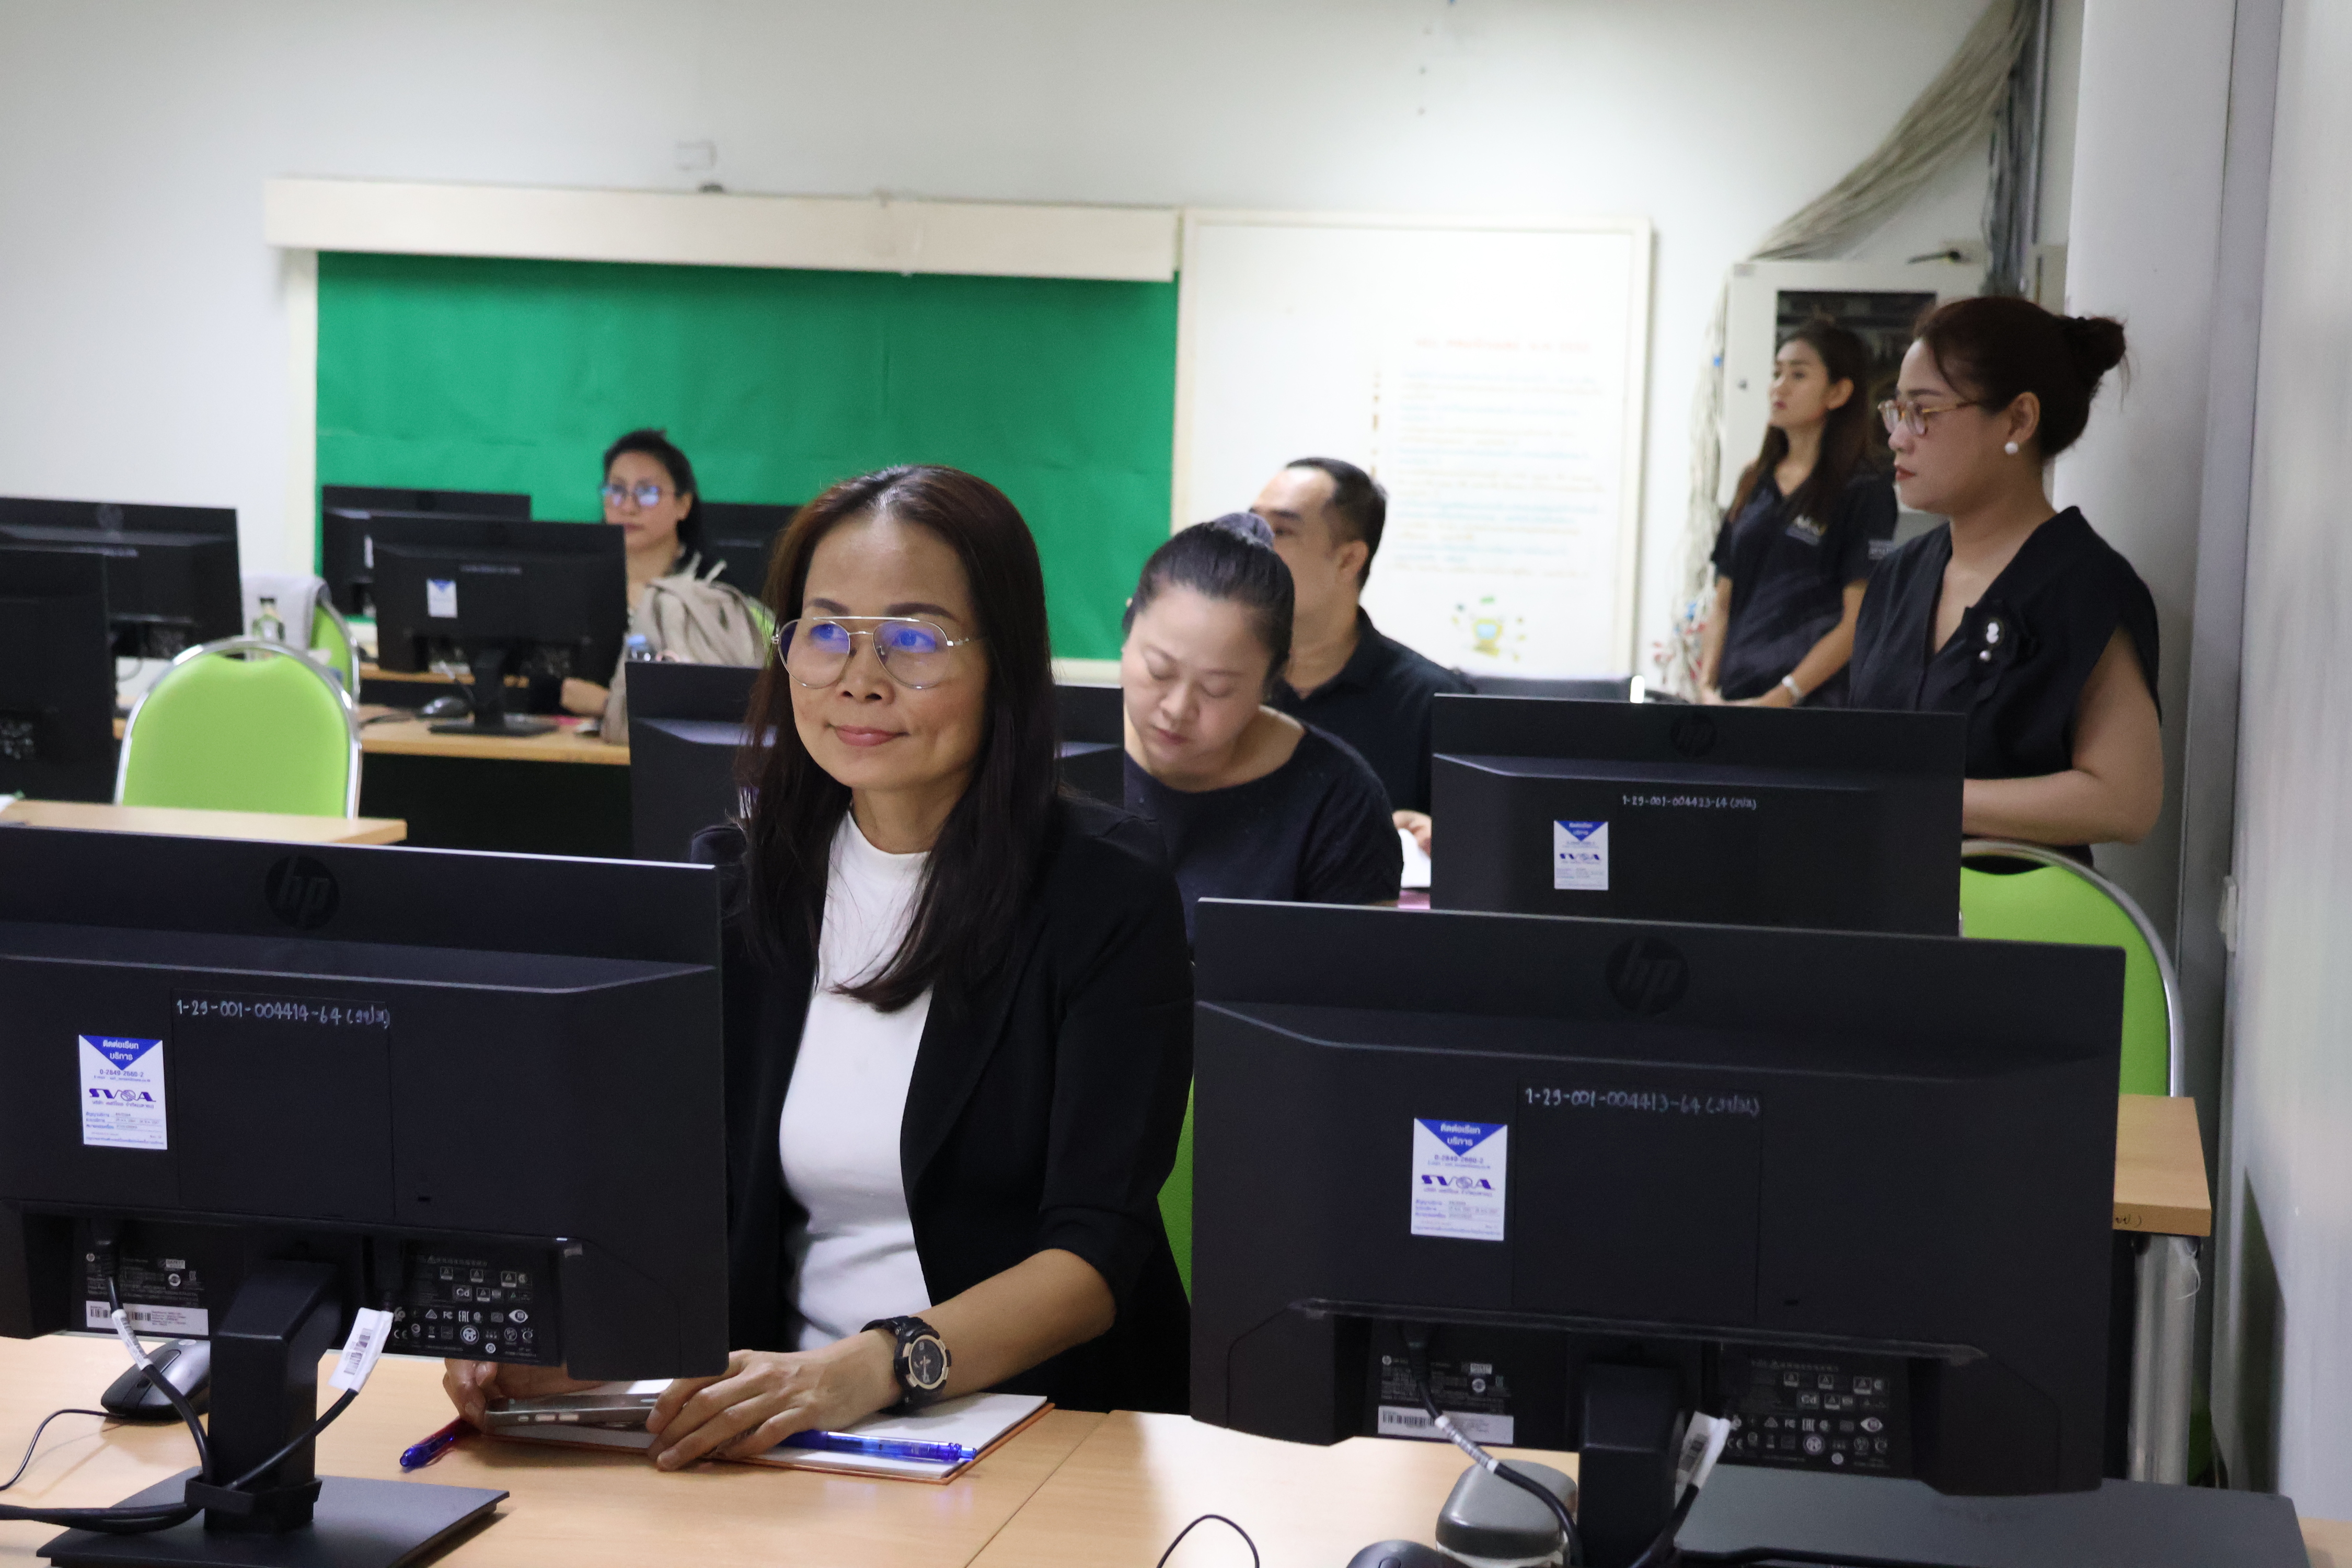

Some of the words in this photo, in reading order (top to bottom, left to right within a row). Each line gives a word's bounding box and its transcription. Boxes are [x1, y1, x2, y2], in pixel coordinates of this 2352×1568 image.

[103, 1040, 139, 1050] ติดต่อเรียก
[110, 1052, 133, 1060] บริการ
